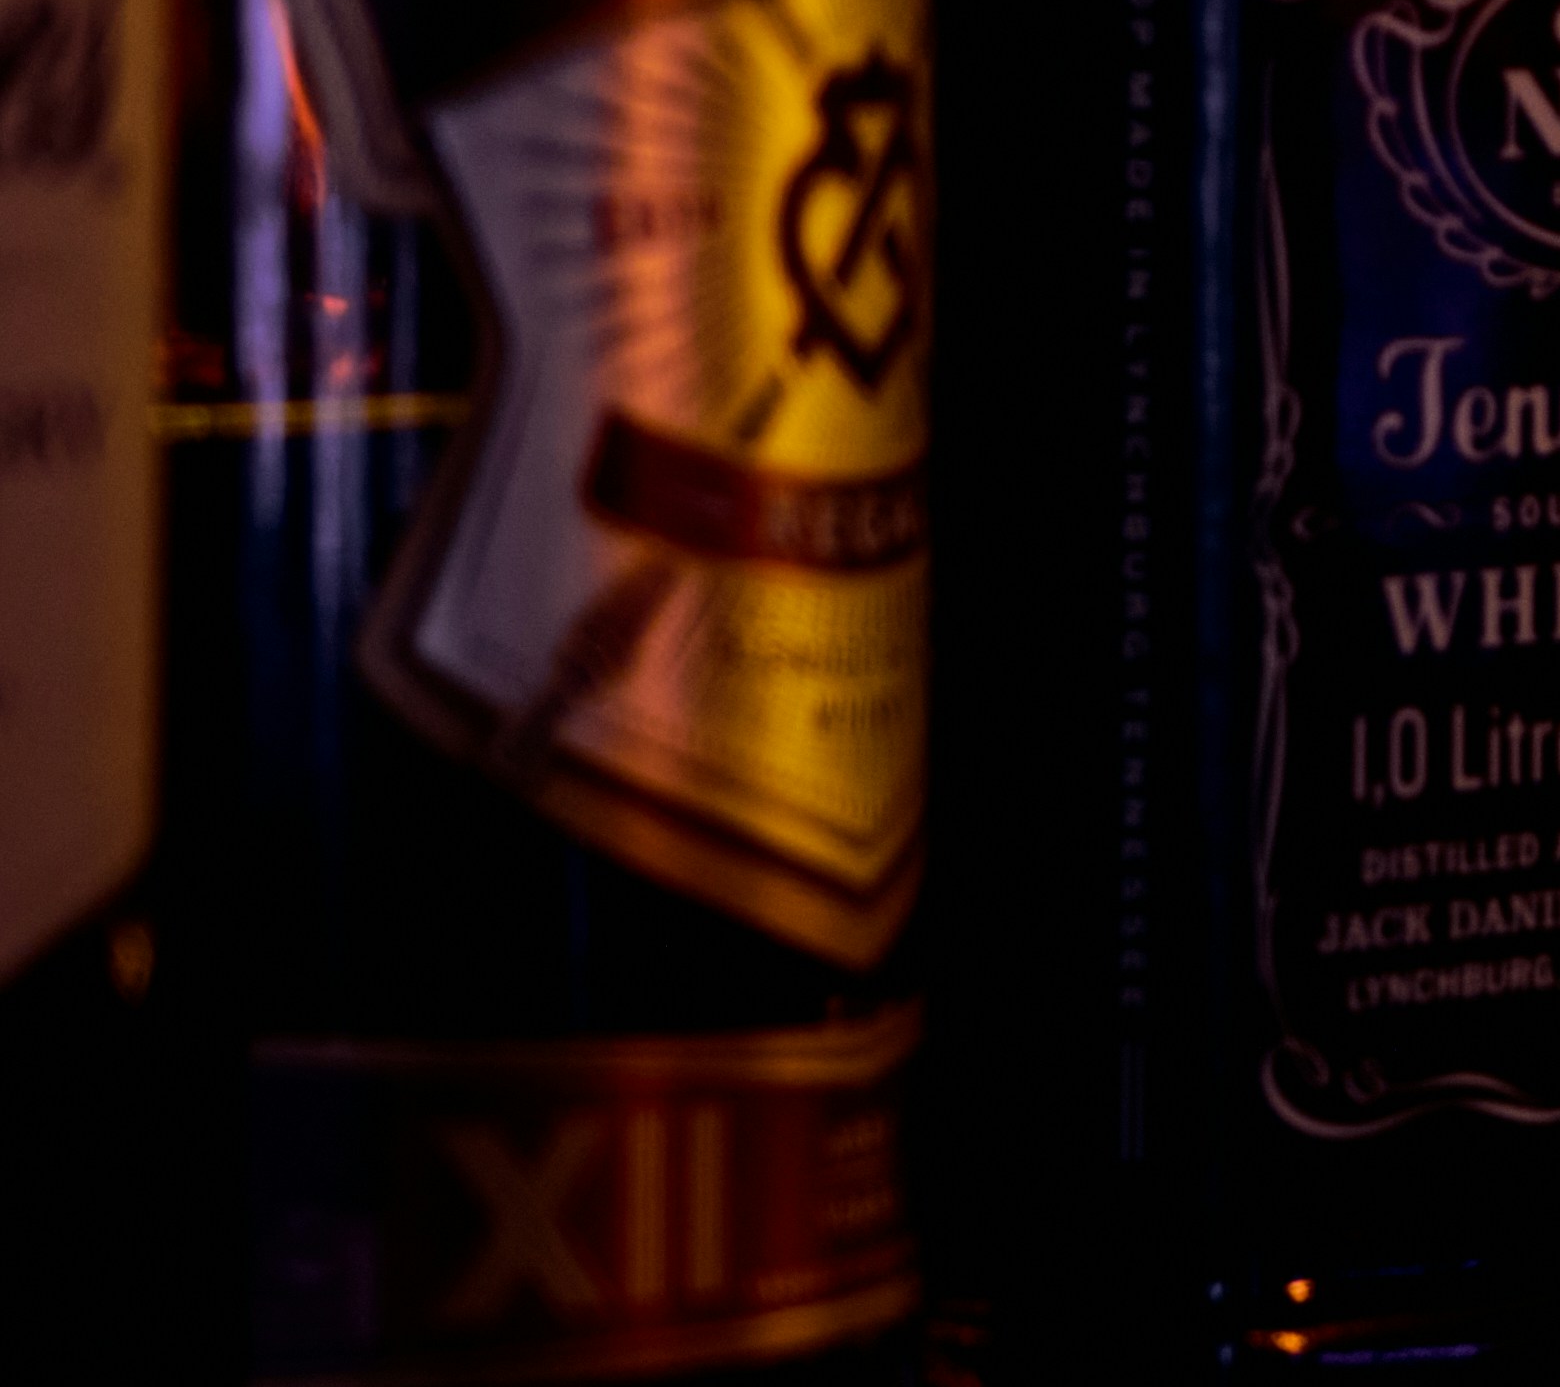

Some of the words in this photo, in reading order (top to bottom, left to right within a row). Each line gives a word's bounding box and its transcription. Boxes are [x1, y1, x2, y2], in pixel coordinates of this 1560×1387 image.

[1358, 829, 1543, 889] DISTILLED
[1314, 899, 1437, 958] JACK
[435, 1103, 727, 1325] XII
